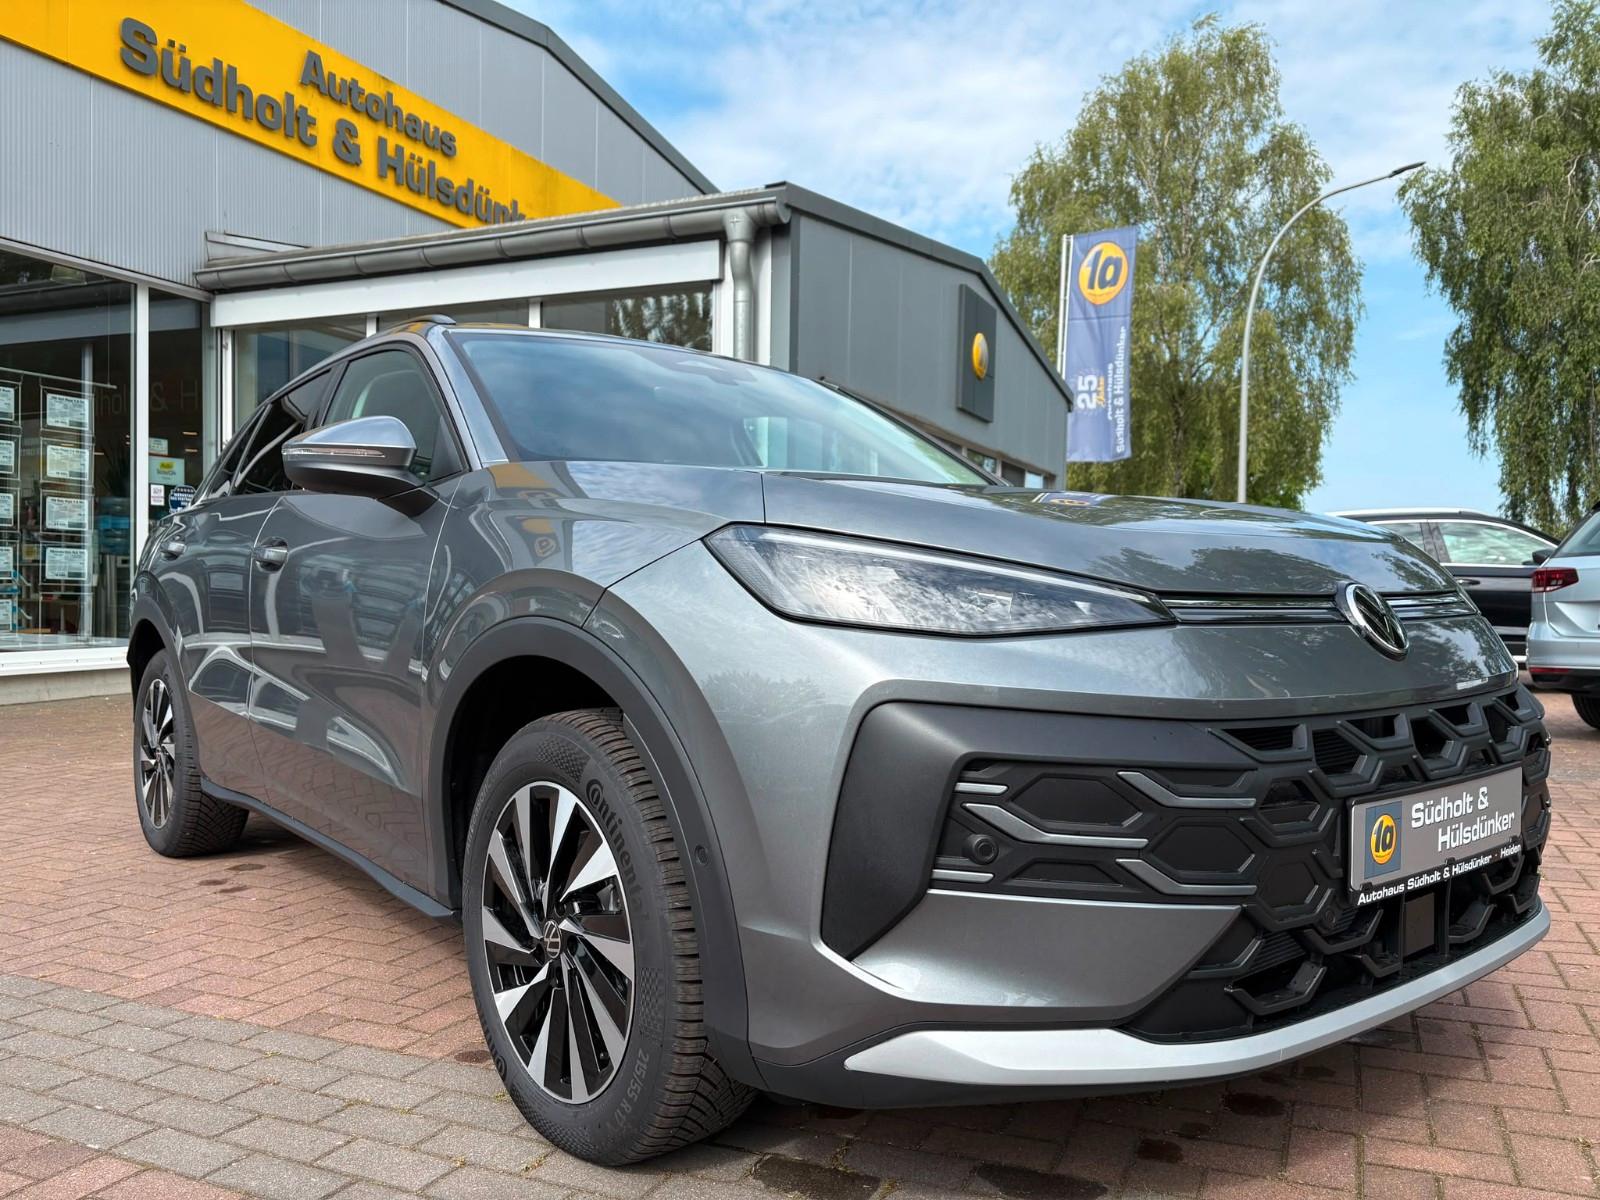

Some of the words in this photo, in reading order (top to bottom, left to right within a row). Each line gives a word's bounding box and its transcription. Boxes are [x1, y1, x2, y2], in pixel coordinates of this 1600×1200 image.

[119, 16, 318, 149] Südholt
[333, 118, 363, 167] &
[377, 136, 527, 224] Hülsdünk
[301, 49, 457, 158] Autohaus
[1114, 326, 1126, 395] Hülsdünker
[1077, 374, 1098, 410] 25
[1114, 396, 1125, 406] &
[1411, 791, 1473, 828] Südholt
[1477, 786, 1489, 810] &
[1438, 811, 1515, 852] Hülsdünker
[1357, 883, 1405, 906] Autohaus
[1407, 870, 1441, 890] Südholt
[1442, 866, 1450, 879] &
[1452, 855, 1492, 876] Hülsdünker
[1500, 843, 1521, 858] Heiden
